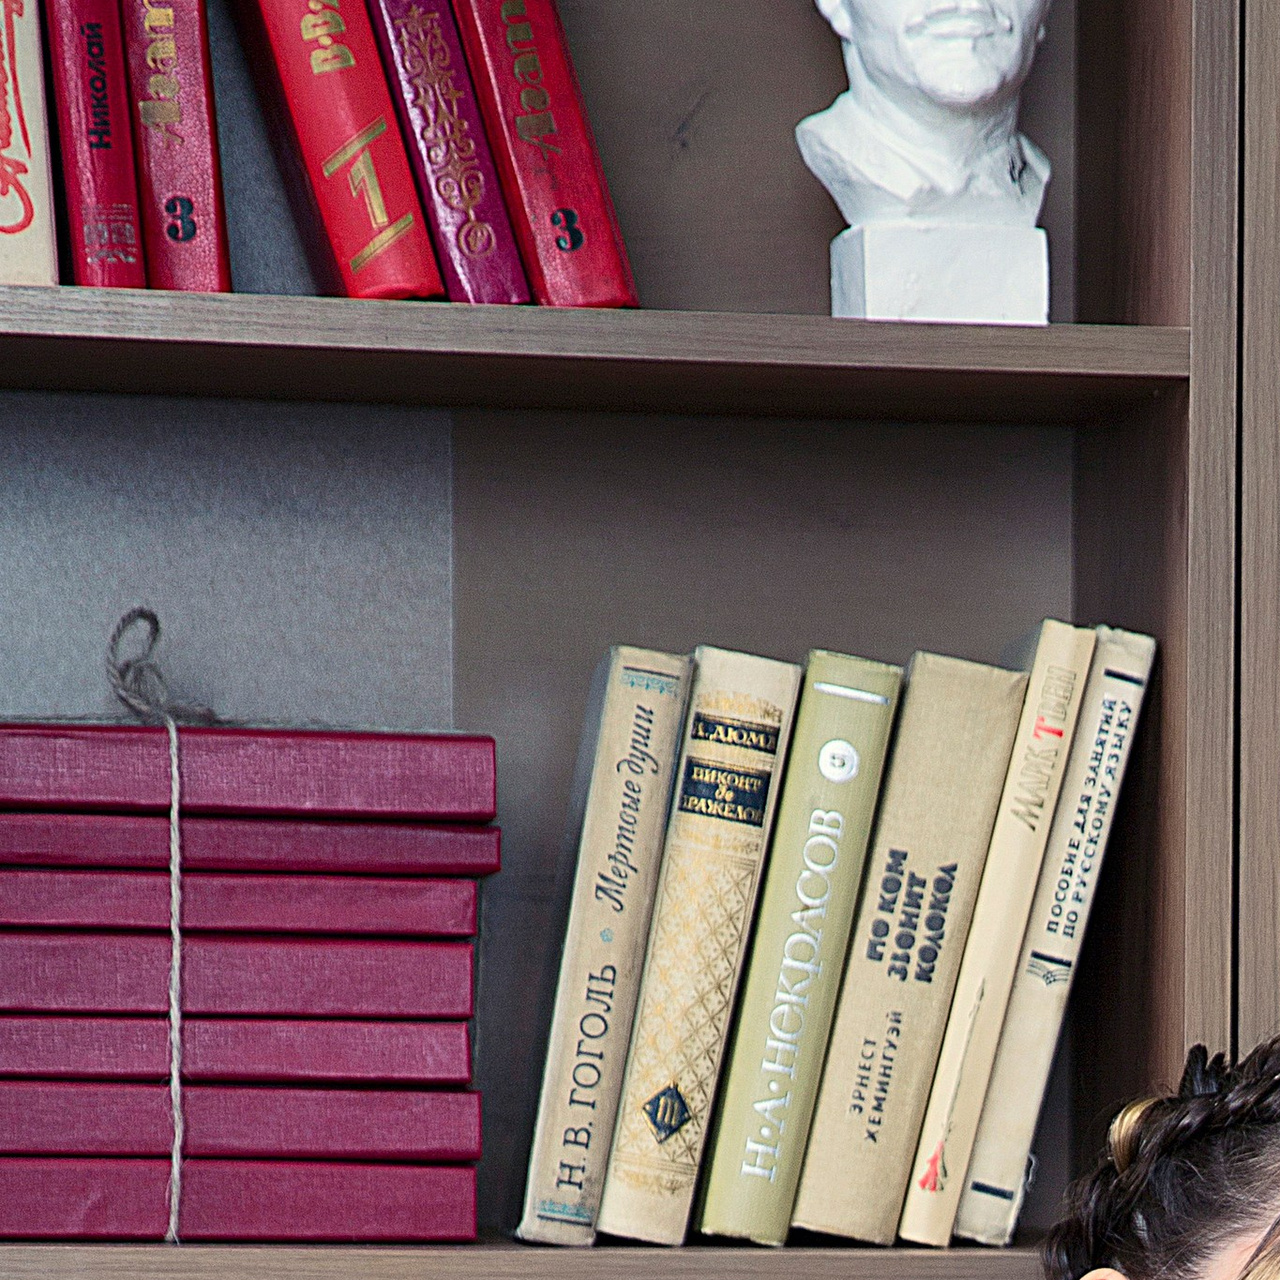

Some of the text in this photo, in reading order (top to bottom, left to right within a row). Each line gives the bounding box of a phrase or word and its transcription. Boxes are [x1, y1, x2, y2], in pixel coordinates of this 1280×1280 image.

[82, 22, 112, 150] Николай
[165, 196, 197, 243] 3
[551, 207, 584, 252] 3
[616, 703, 660, 775] души
[1046, 697, 1118, 934] ПОСОБИЕ ДЛЯ ЗАНЯТИЙ
[1062, 700, 1133, 940] ПО РУССКОМУ ЯЗЫКУ
[866, 848, 909, 963] ПО КОМ
[888, 871, 928, 984] ЗВОНИТ
[914, 862, 959, 984] КОЛОКОЛ
[567, 963, 617, 1111] ГОГОЛЬ
[849, 1037, 878, 1117] ЭРНЕСТ
[864, 1010, 904, 1144] ХЕМИНГУЭЙ
